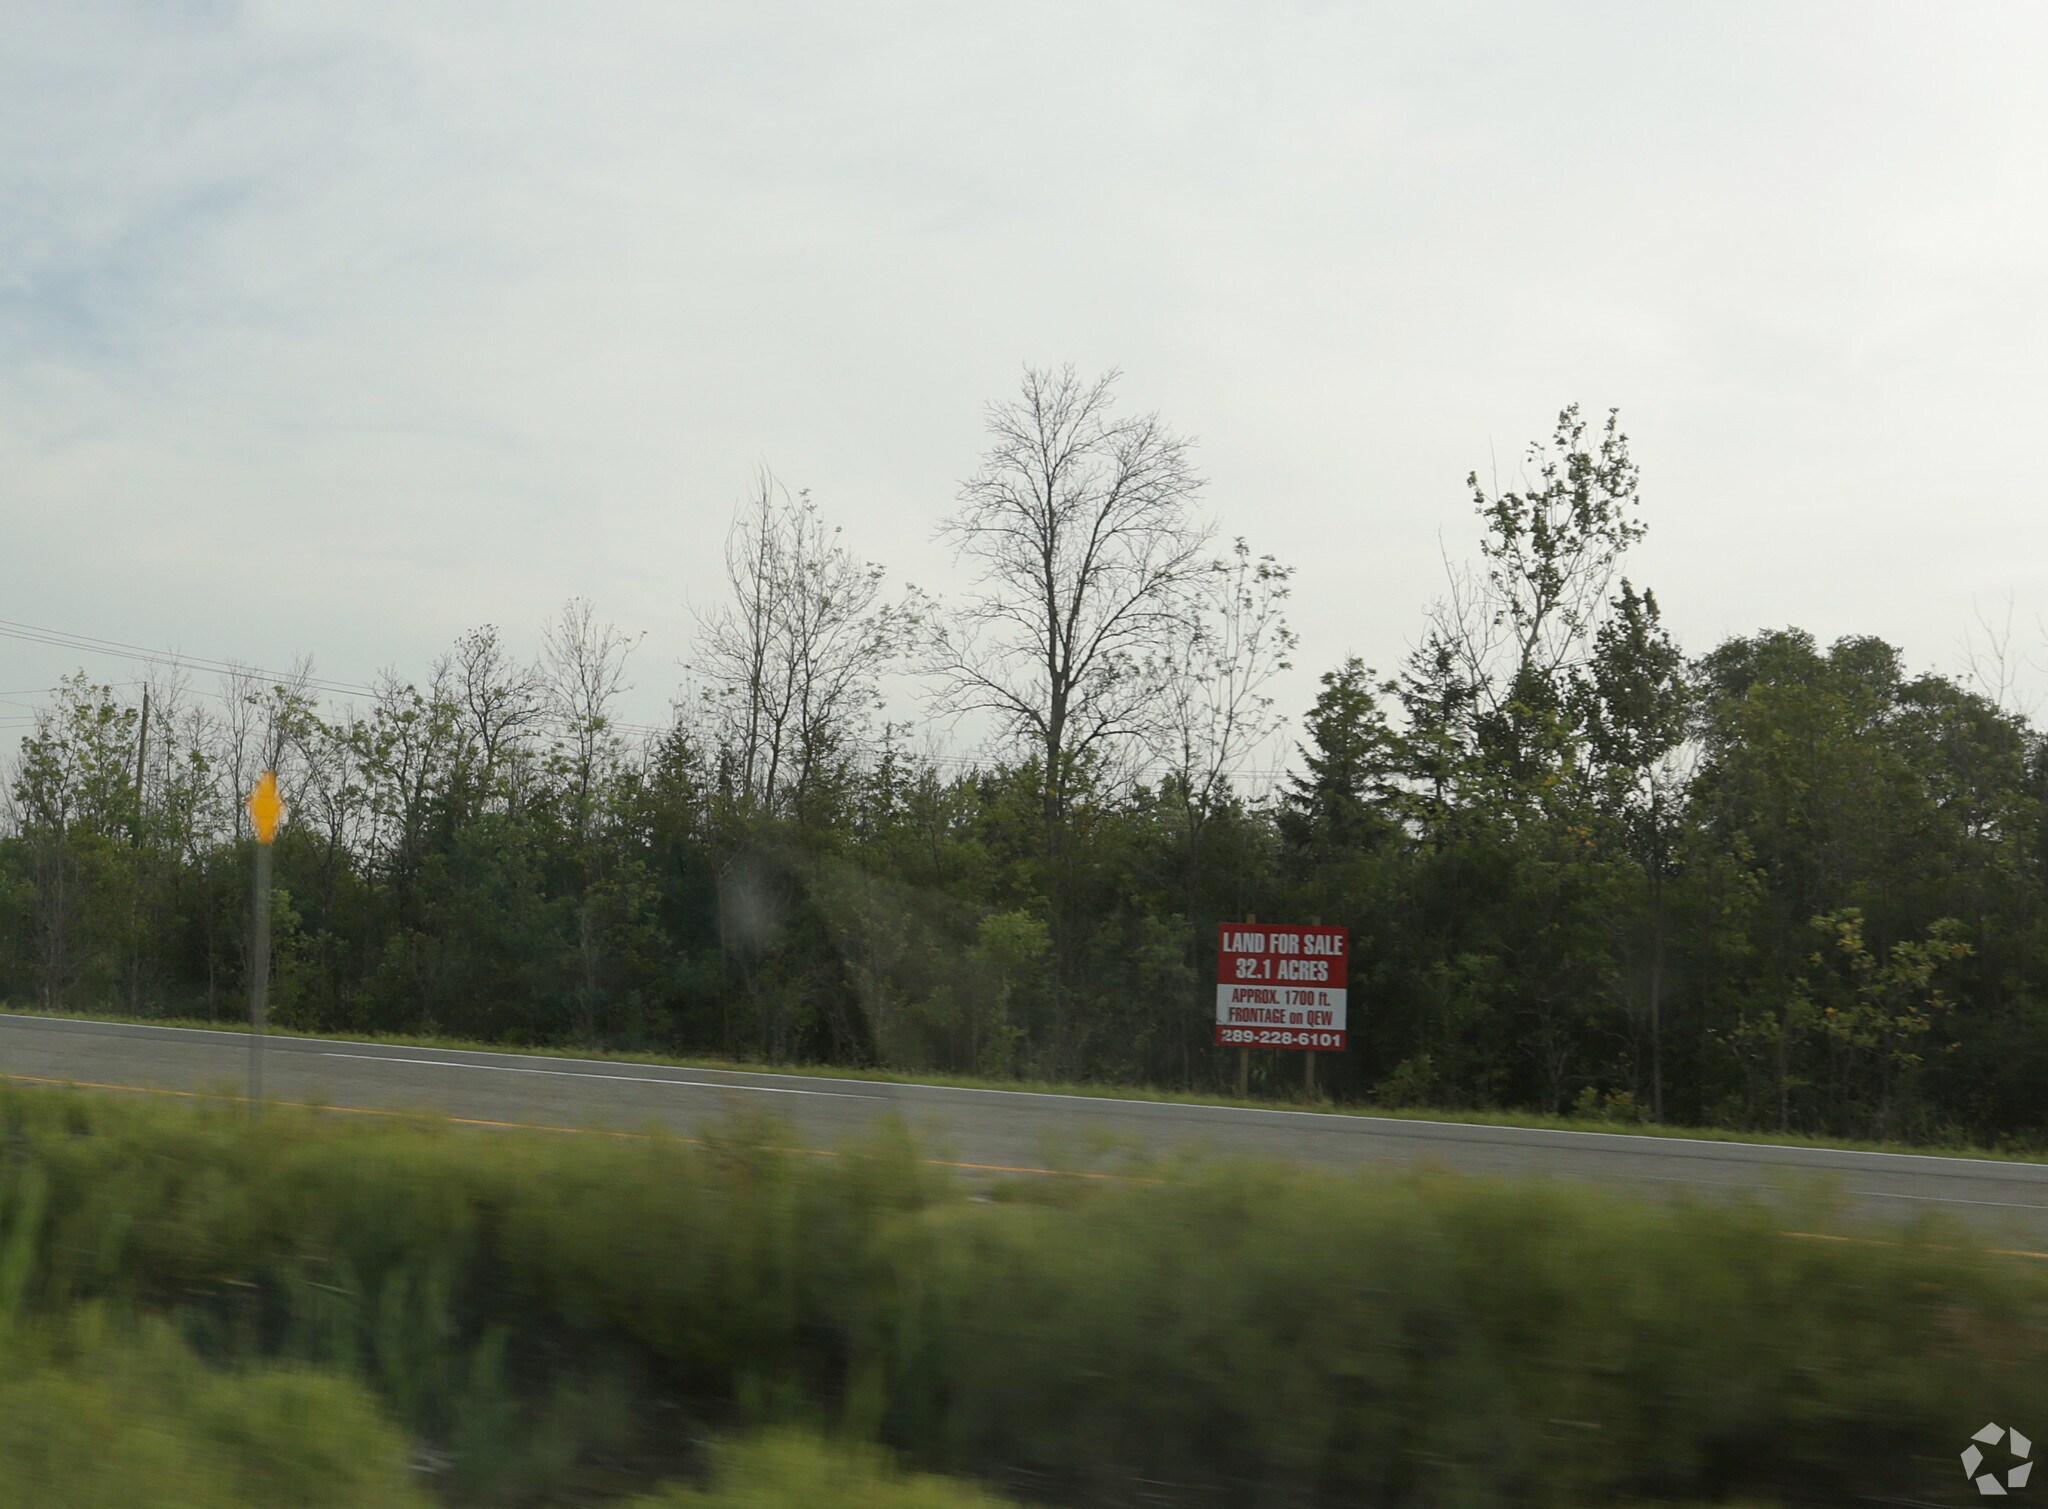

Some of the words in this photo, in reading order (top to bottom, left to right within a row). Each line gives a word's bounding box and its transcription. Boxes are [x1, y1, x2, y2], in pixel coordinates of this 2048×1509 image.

[1223, 932, 1265, 953] LAND
[1270, 933, 1299, 954] FOR
[1303, 934, 1343, 955] SALE
[1236, 958, 1271, 979] 32.1
[1277, 960, 1328, 981] ACRES
[1232, 988, 1280, 1004] APPROX.
[1285, 990, 1315, 1006] 1700
[1318, 992, 1331, 1006] ft.
[1229, 1007, 1286, 1024] FRONTAGE
[1289, 1012, 1303, 1025] on
[1307, 1010, 1333, 1027] QEW
[1221, 1029, 1340, 1046] 289-228-6101
